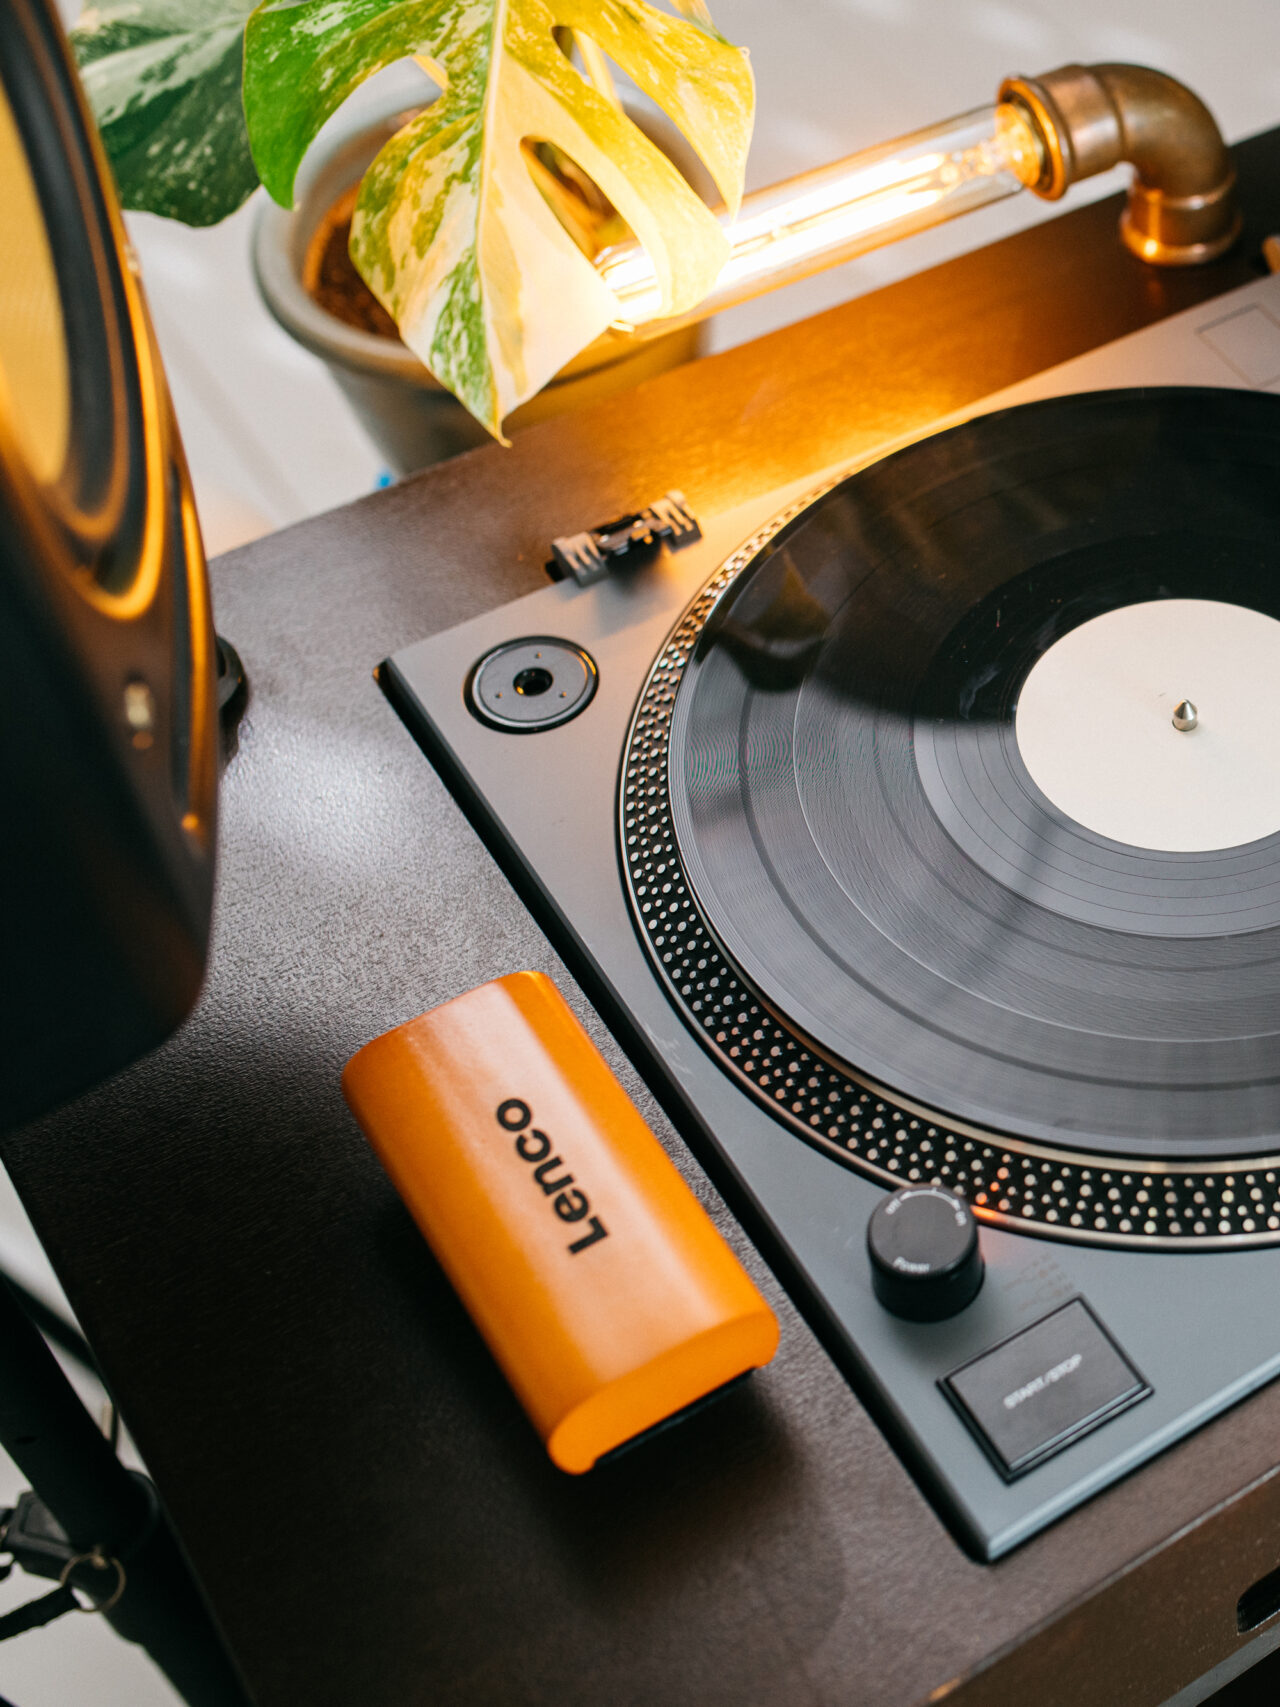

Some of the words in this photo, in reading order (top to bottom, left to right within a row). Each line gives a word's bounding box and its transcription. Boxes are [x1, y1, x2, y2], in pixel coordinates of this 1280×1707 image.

[496, 1098, 609, 1256] Lenco
[893, 1256, 930, 1273] Power
[1003, 1353, 1083, 1410] START/STOP
